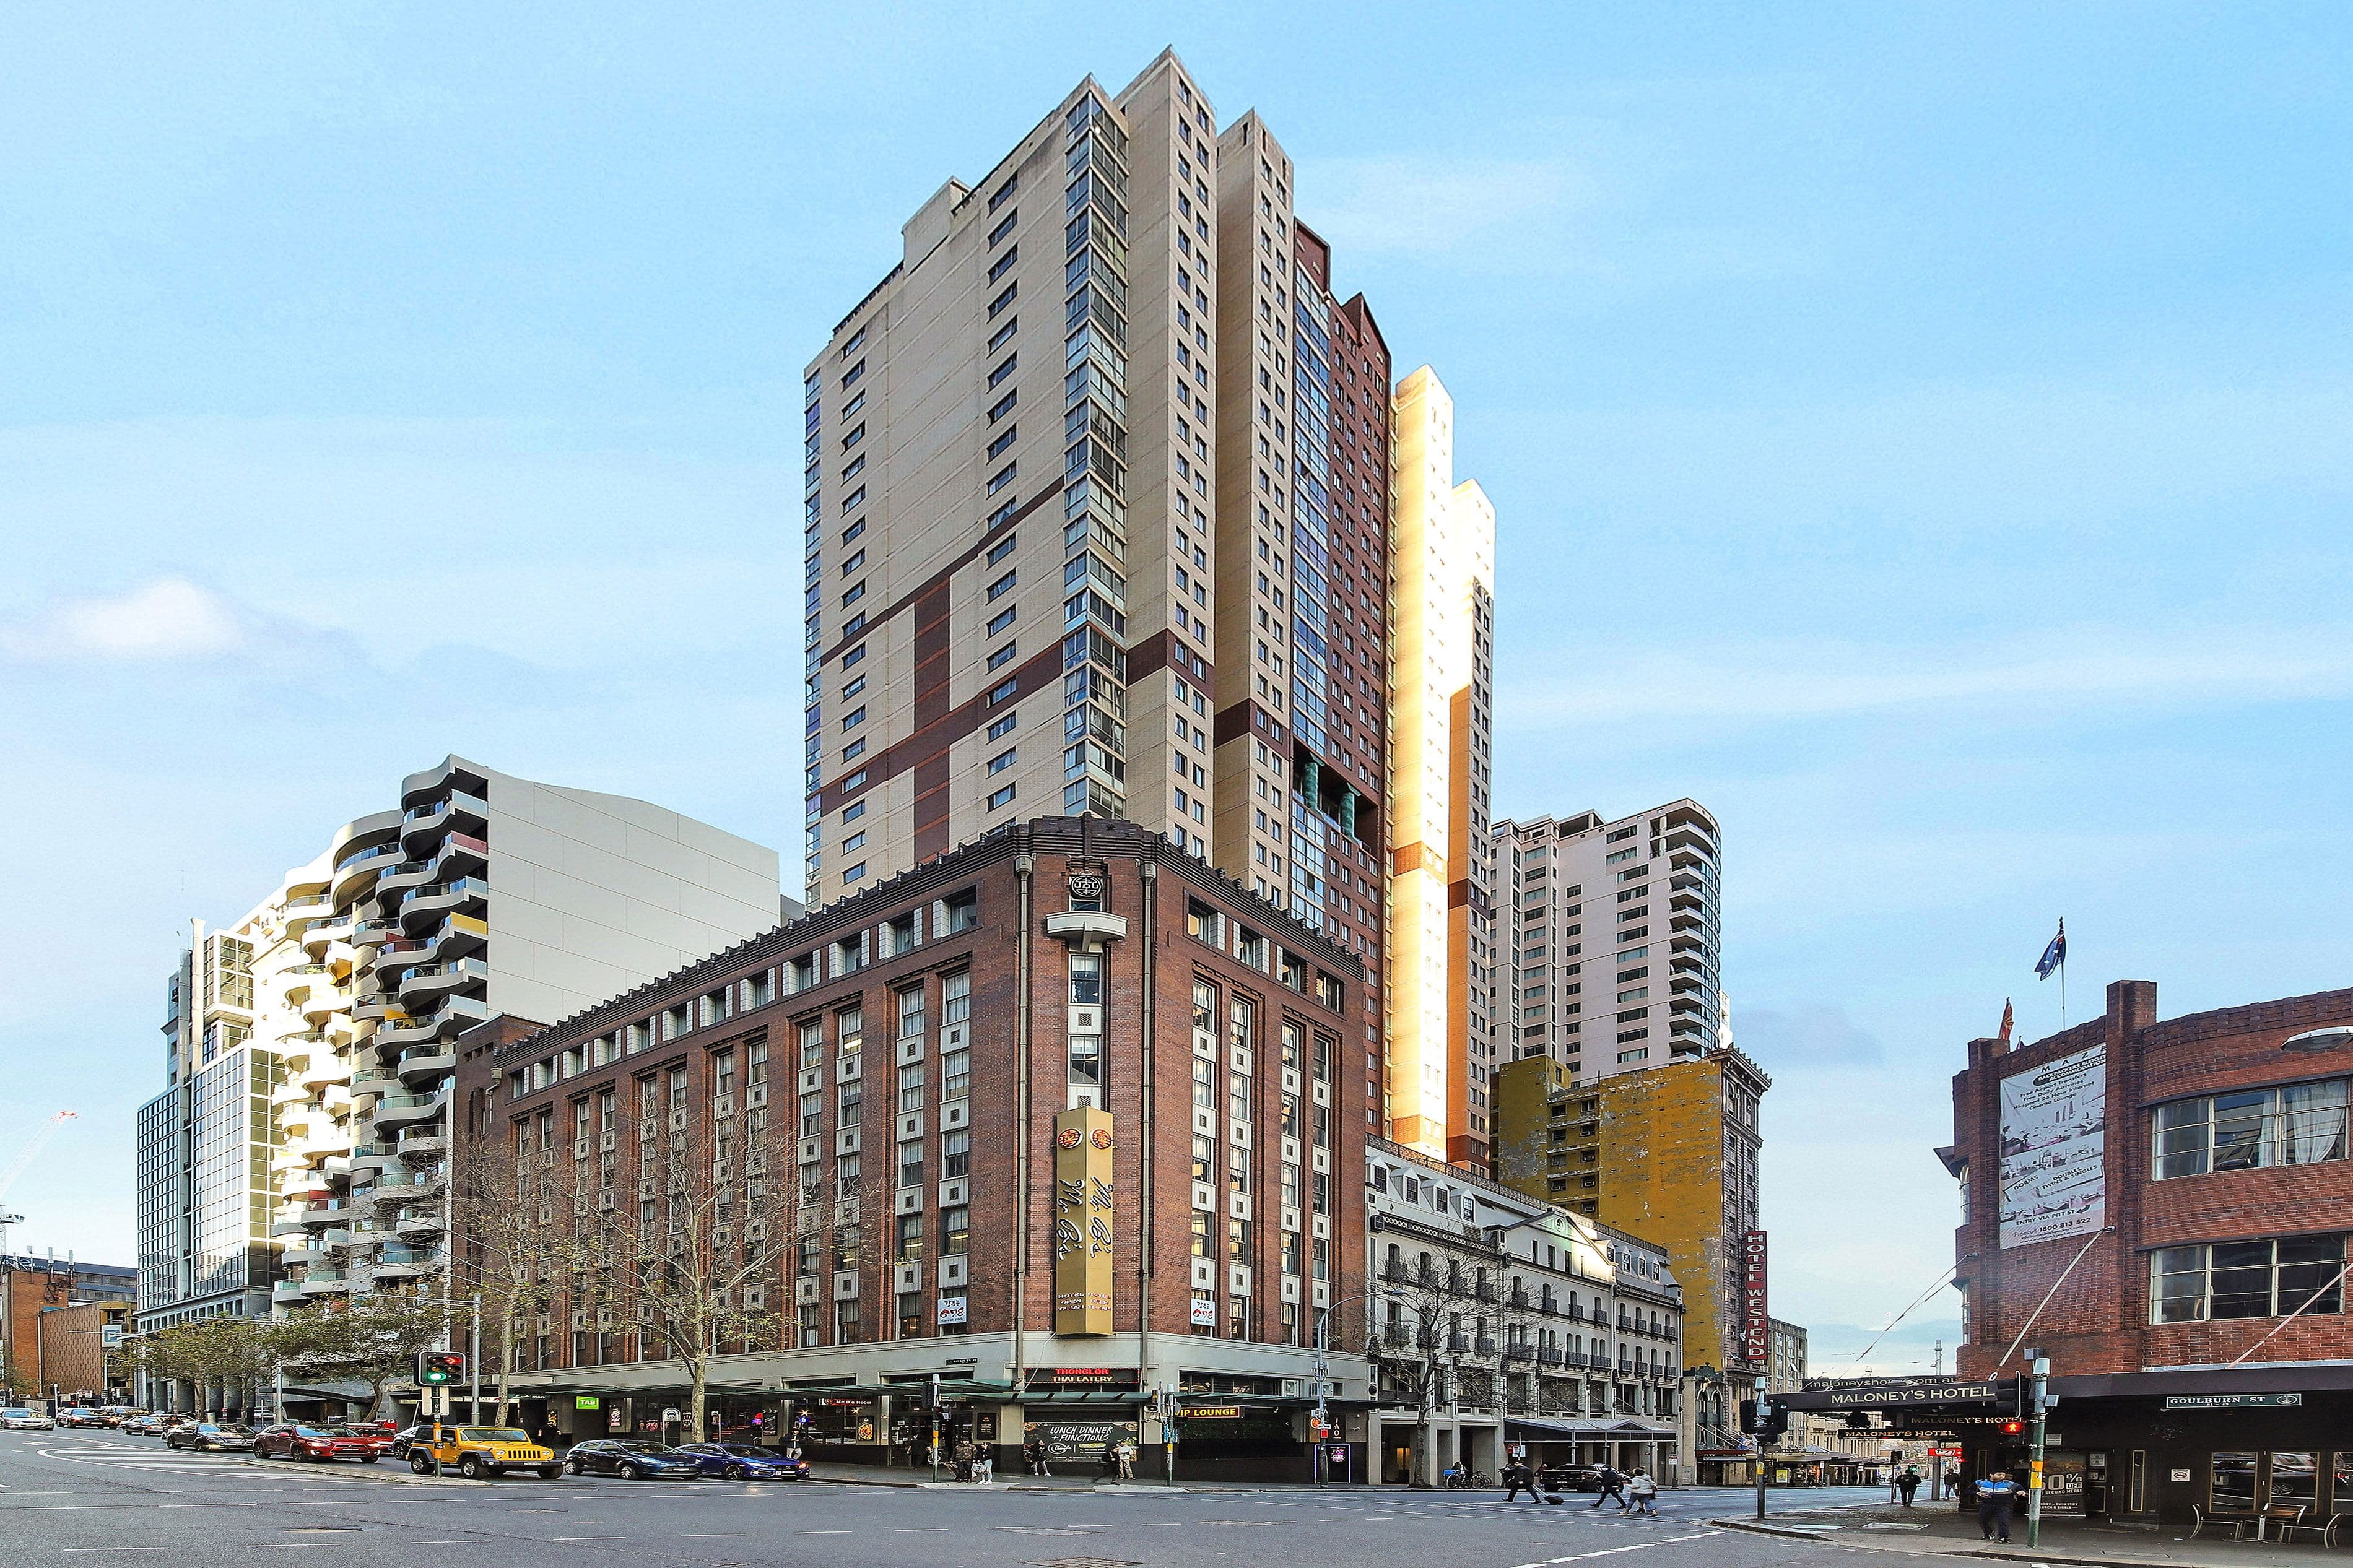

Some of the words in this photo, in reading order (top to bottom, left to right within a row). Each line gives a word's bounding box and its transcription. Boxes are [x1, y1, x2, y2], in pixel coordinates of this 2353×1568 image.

[2041, 1046, 2107, 1073] MAZE
[2038, 1063, 2080, 1081] BACKPACKERS
[2049, 1059, 2106, 1081] ACCOMMODATION
[2035, 1083, 2056, 1093] Airport
[2058, 1073, 2087, 1084] Transfers
[2051, 1090, 2068, 1098] Hour
[2069, 1081, 2095, 1092] Internet
[2055, 1080, 2084, 1091] Activities
[2029, 1101, 2052, 1110] Cinema
[2054, 1093, 2077, 1102] Lounge
[2014, 1176, 2039, 1190] DORMS
[2042, 1179, 2063, 1189] TWINS
[2071, 1165, 2097, 1178] SINGLES
[2016, 1218, 2037, 1226] ENTRY
[1747, 1234, 1765, 1281] HOTEL
[940, 1307, 964, 1318] 678
[1193, 1309, 1213, 1319] 678
[1832, 1390, 1925, 1404] MALONEY'S
[1931, 1387, 1996, 1399] HOTEL
[1194, 1408, 1236, 1416] LOUNGE
[1050, 1426, 1078, 1434] LUNCH
[1079, 1426, 1113, 1434] DINNER
